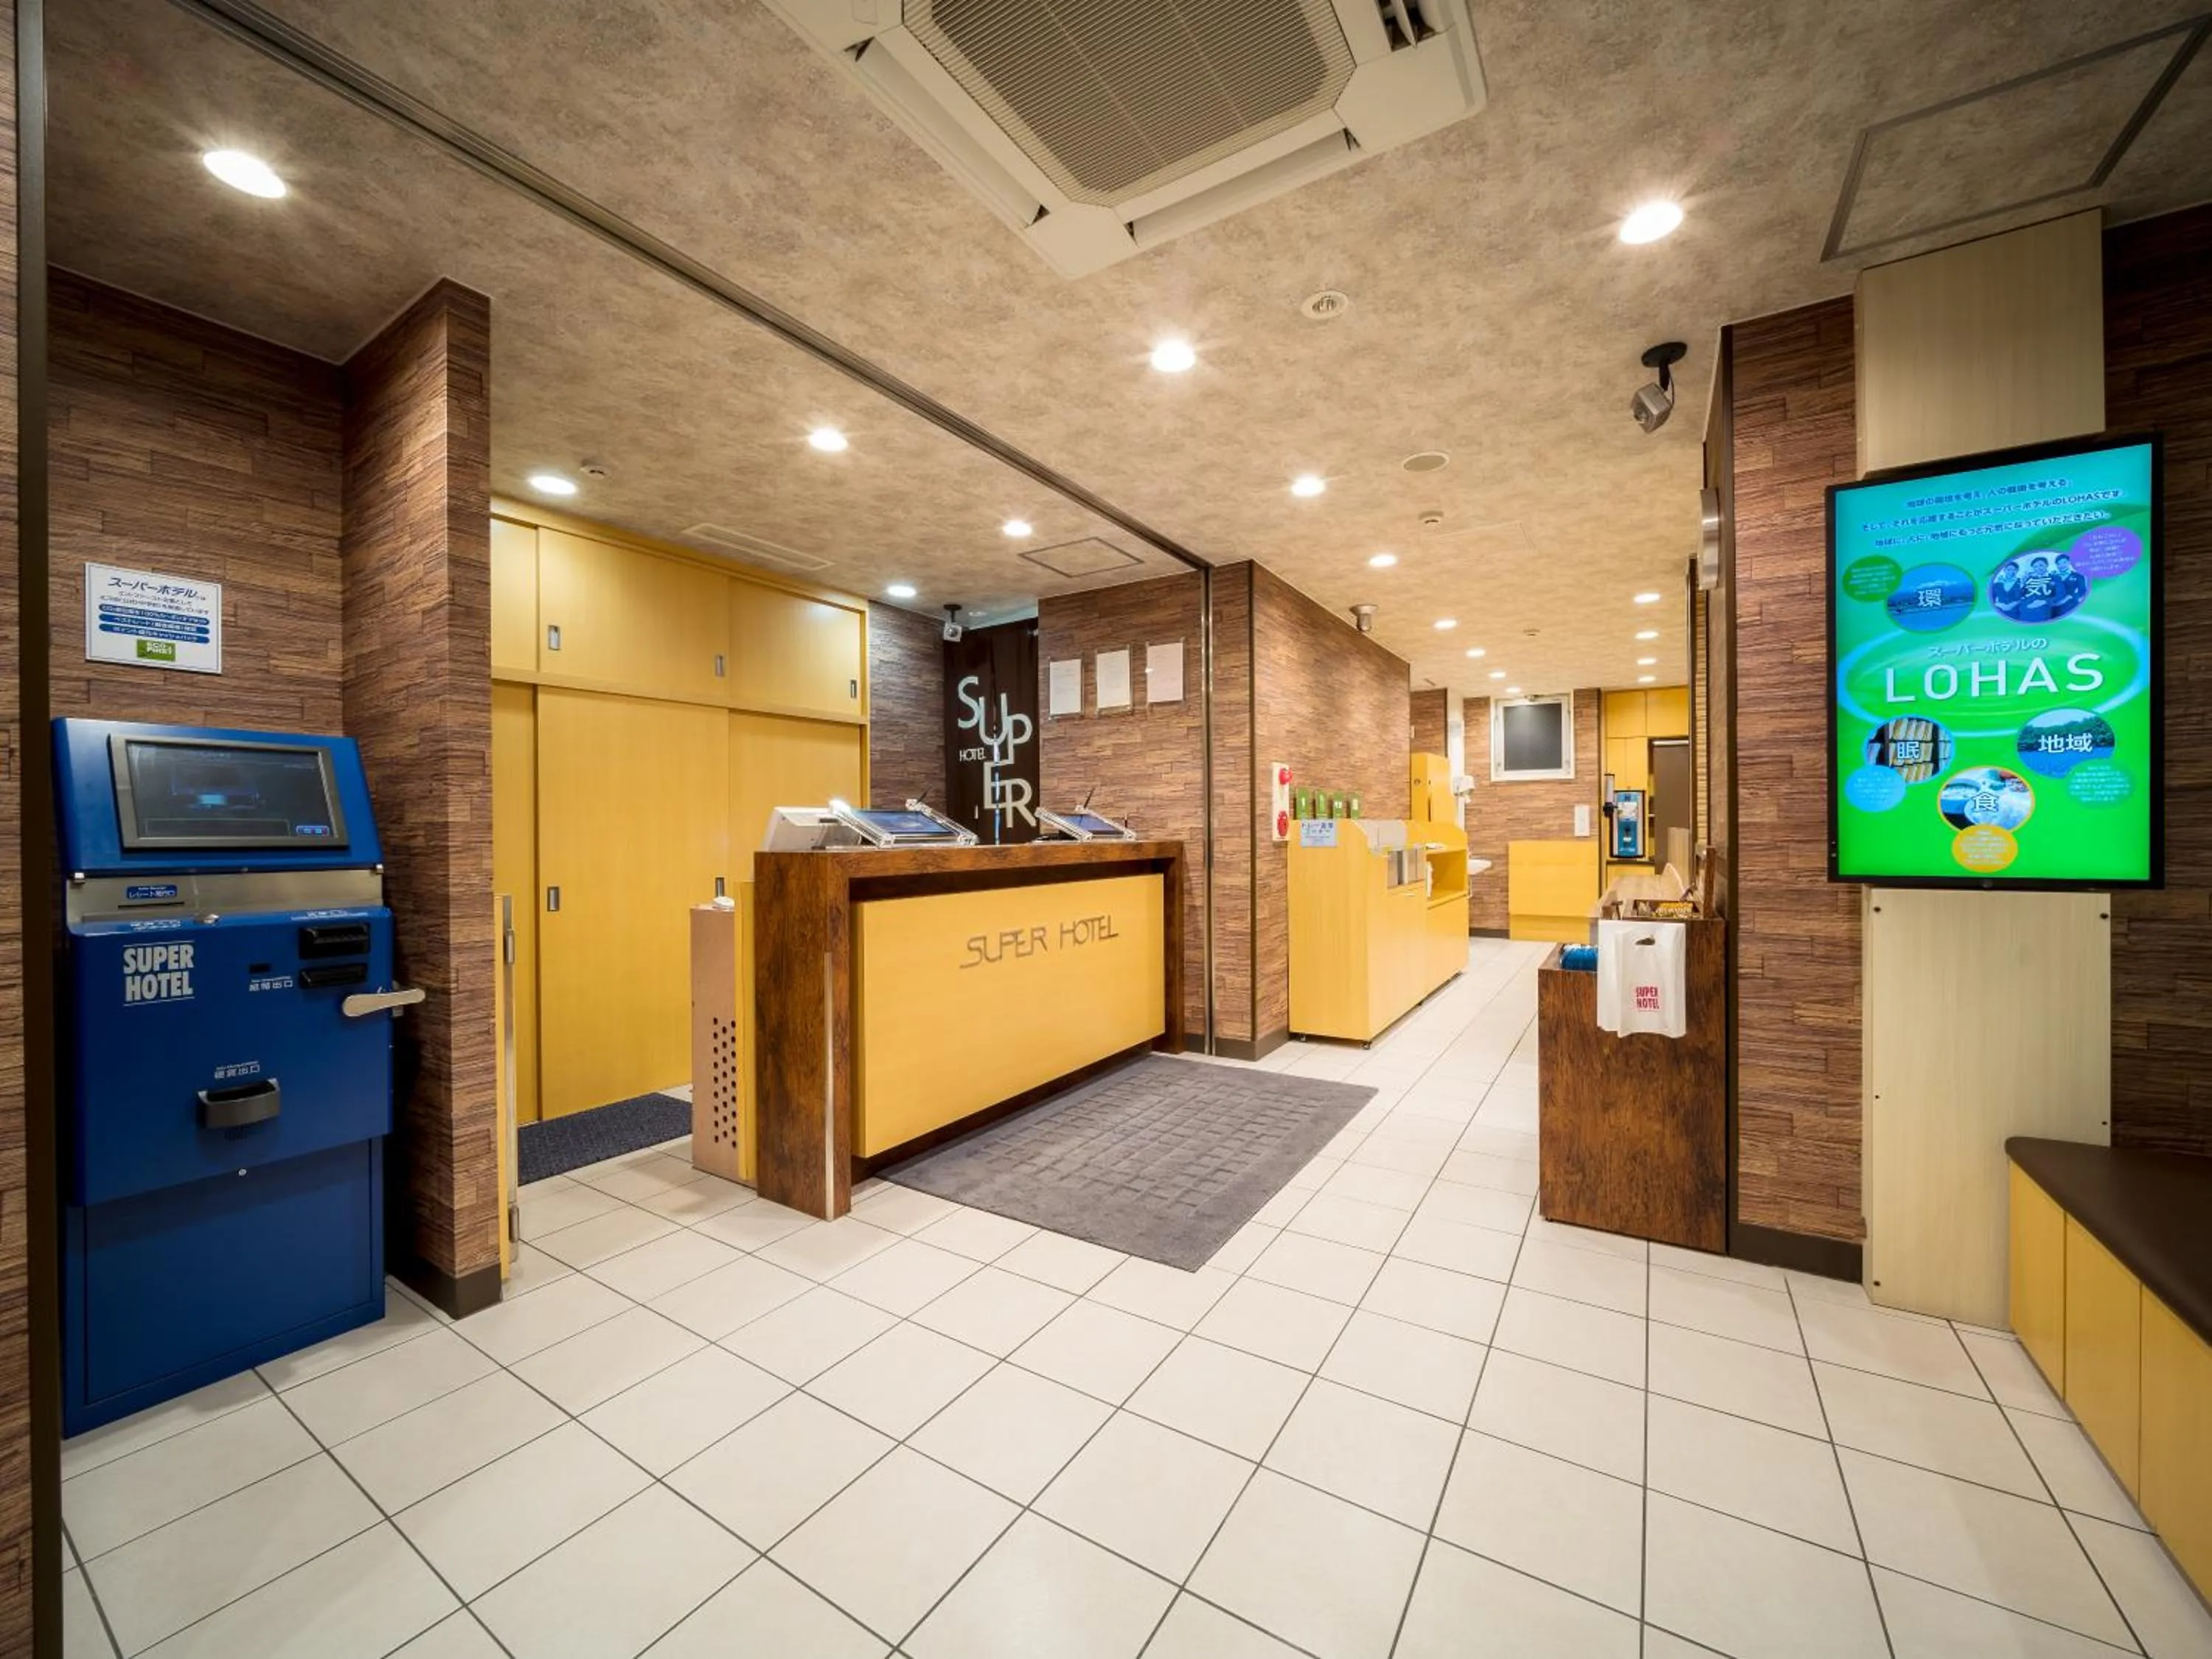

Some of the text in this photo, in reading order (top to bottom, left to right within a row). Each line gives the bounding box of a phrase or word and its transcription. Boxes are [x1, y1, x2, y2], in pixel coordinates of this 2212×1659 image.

[2026, 575, 2052, 597] 気
[1919, 589, 1941, 608] 環
[1929, 638, 2048, 658] スーパーホテルの
[1886, 653, 2104, 703] LOHAS
[1896, 742, 1920, 759] 眠
[2038, 733, 2093, 753] 地域
[959, 747, 986, 762] HOTEL
[1972, 791, 1998, 813] 食
[959, 915, 1119, 969] SUPER HOTEL
[123, 944, 194, 974] SUPER
[125, 970, 194, 1002] HOTEL
[1635, 986, 1658, 998] SUPER
[1636, 998, 1660, 1009] HOTEL
